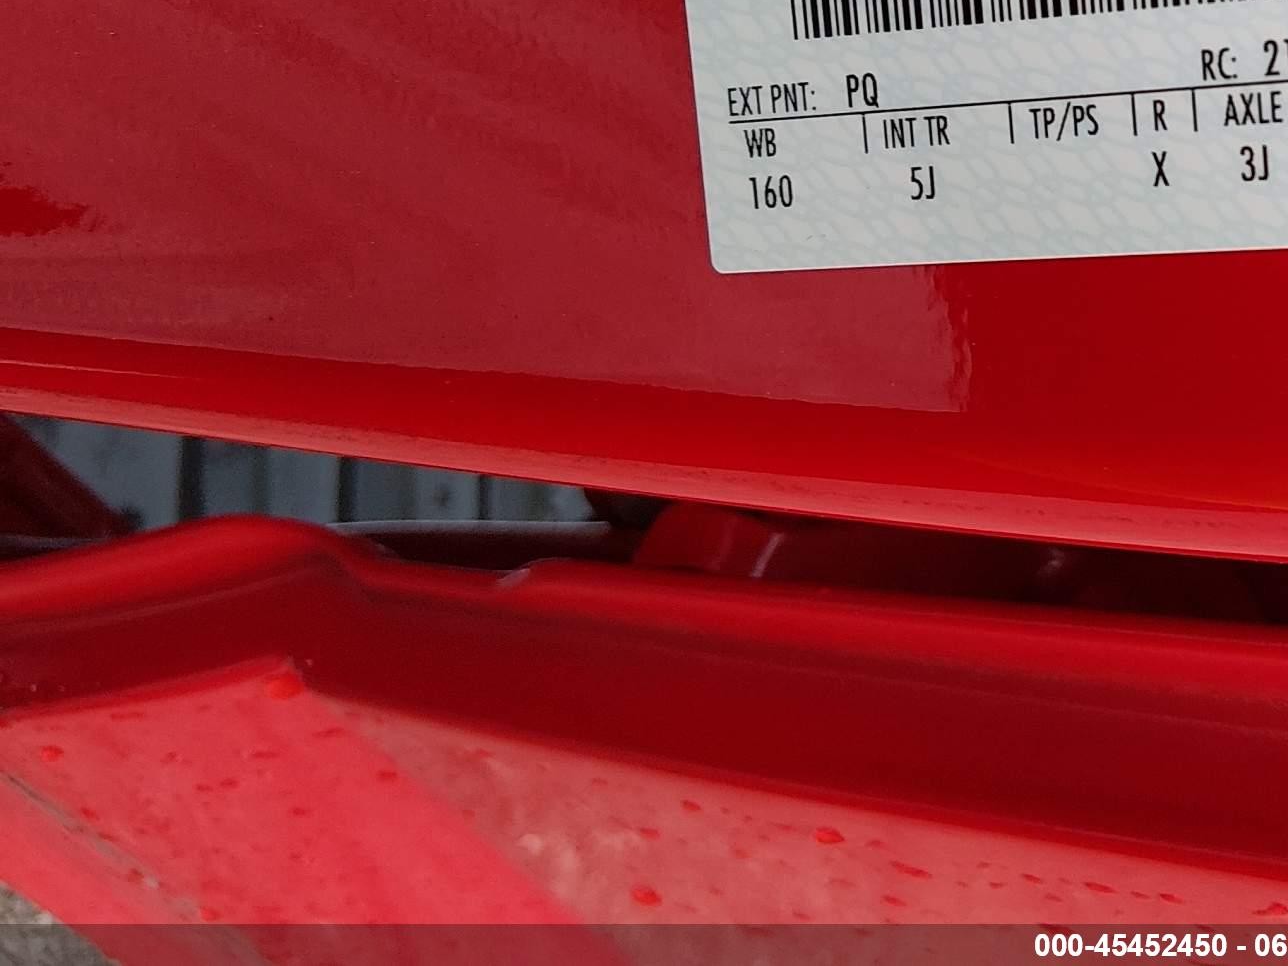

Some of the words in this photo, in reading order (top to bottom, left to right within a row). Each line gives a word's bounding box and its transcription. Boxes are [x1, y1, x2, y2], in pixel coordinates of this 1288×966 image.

[1200, 47, 1238, 82] RC:
[727, 85, 763, 117] EXT
[769, 81, 817, 114] PNT:
[845, 72, 880, 109] PQ
[1223, 90, 1284, 127] AXLE
[882, 116, 918, 150] INT
[922, 114, 951, 147] TR
[1028, 101, 1100, 142] TP/PS
[1152, 99, 1168, 132] R
[742, 127, 777, 159] WB
[1151, 150, 1170, 188] X
[1239, 144, 1270, 182] 3J
[748, 174, 794, 210] 160
[910, 165, 936, 201] 5J
